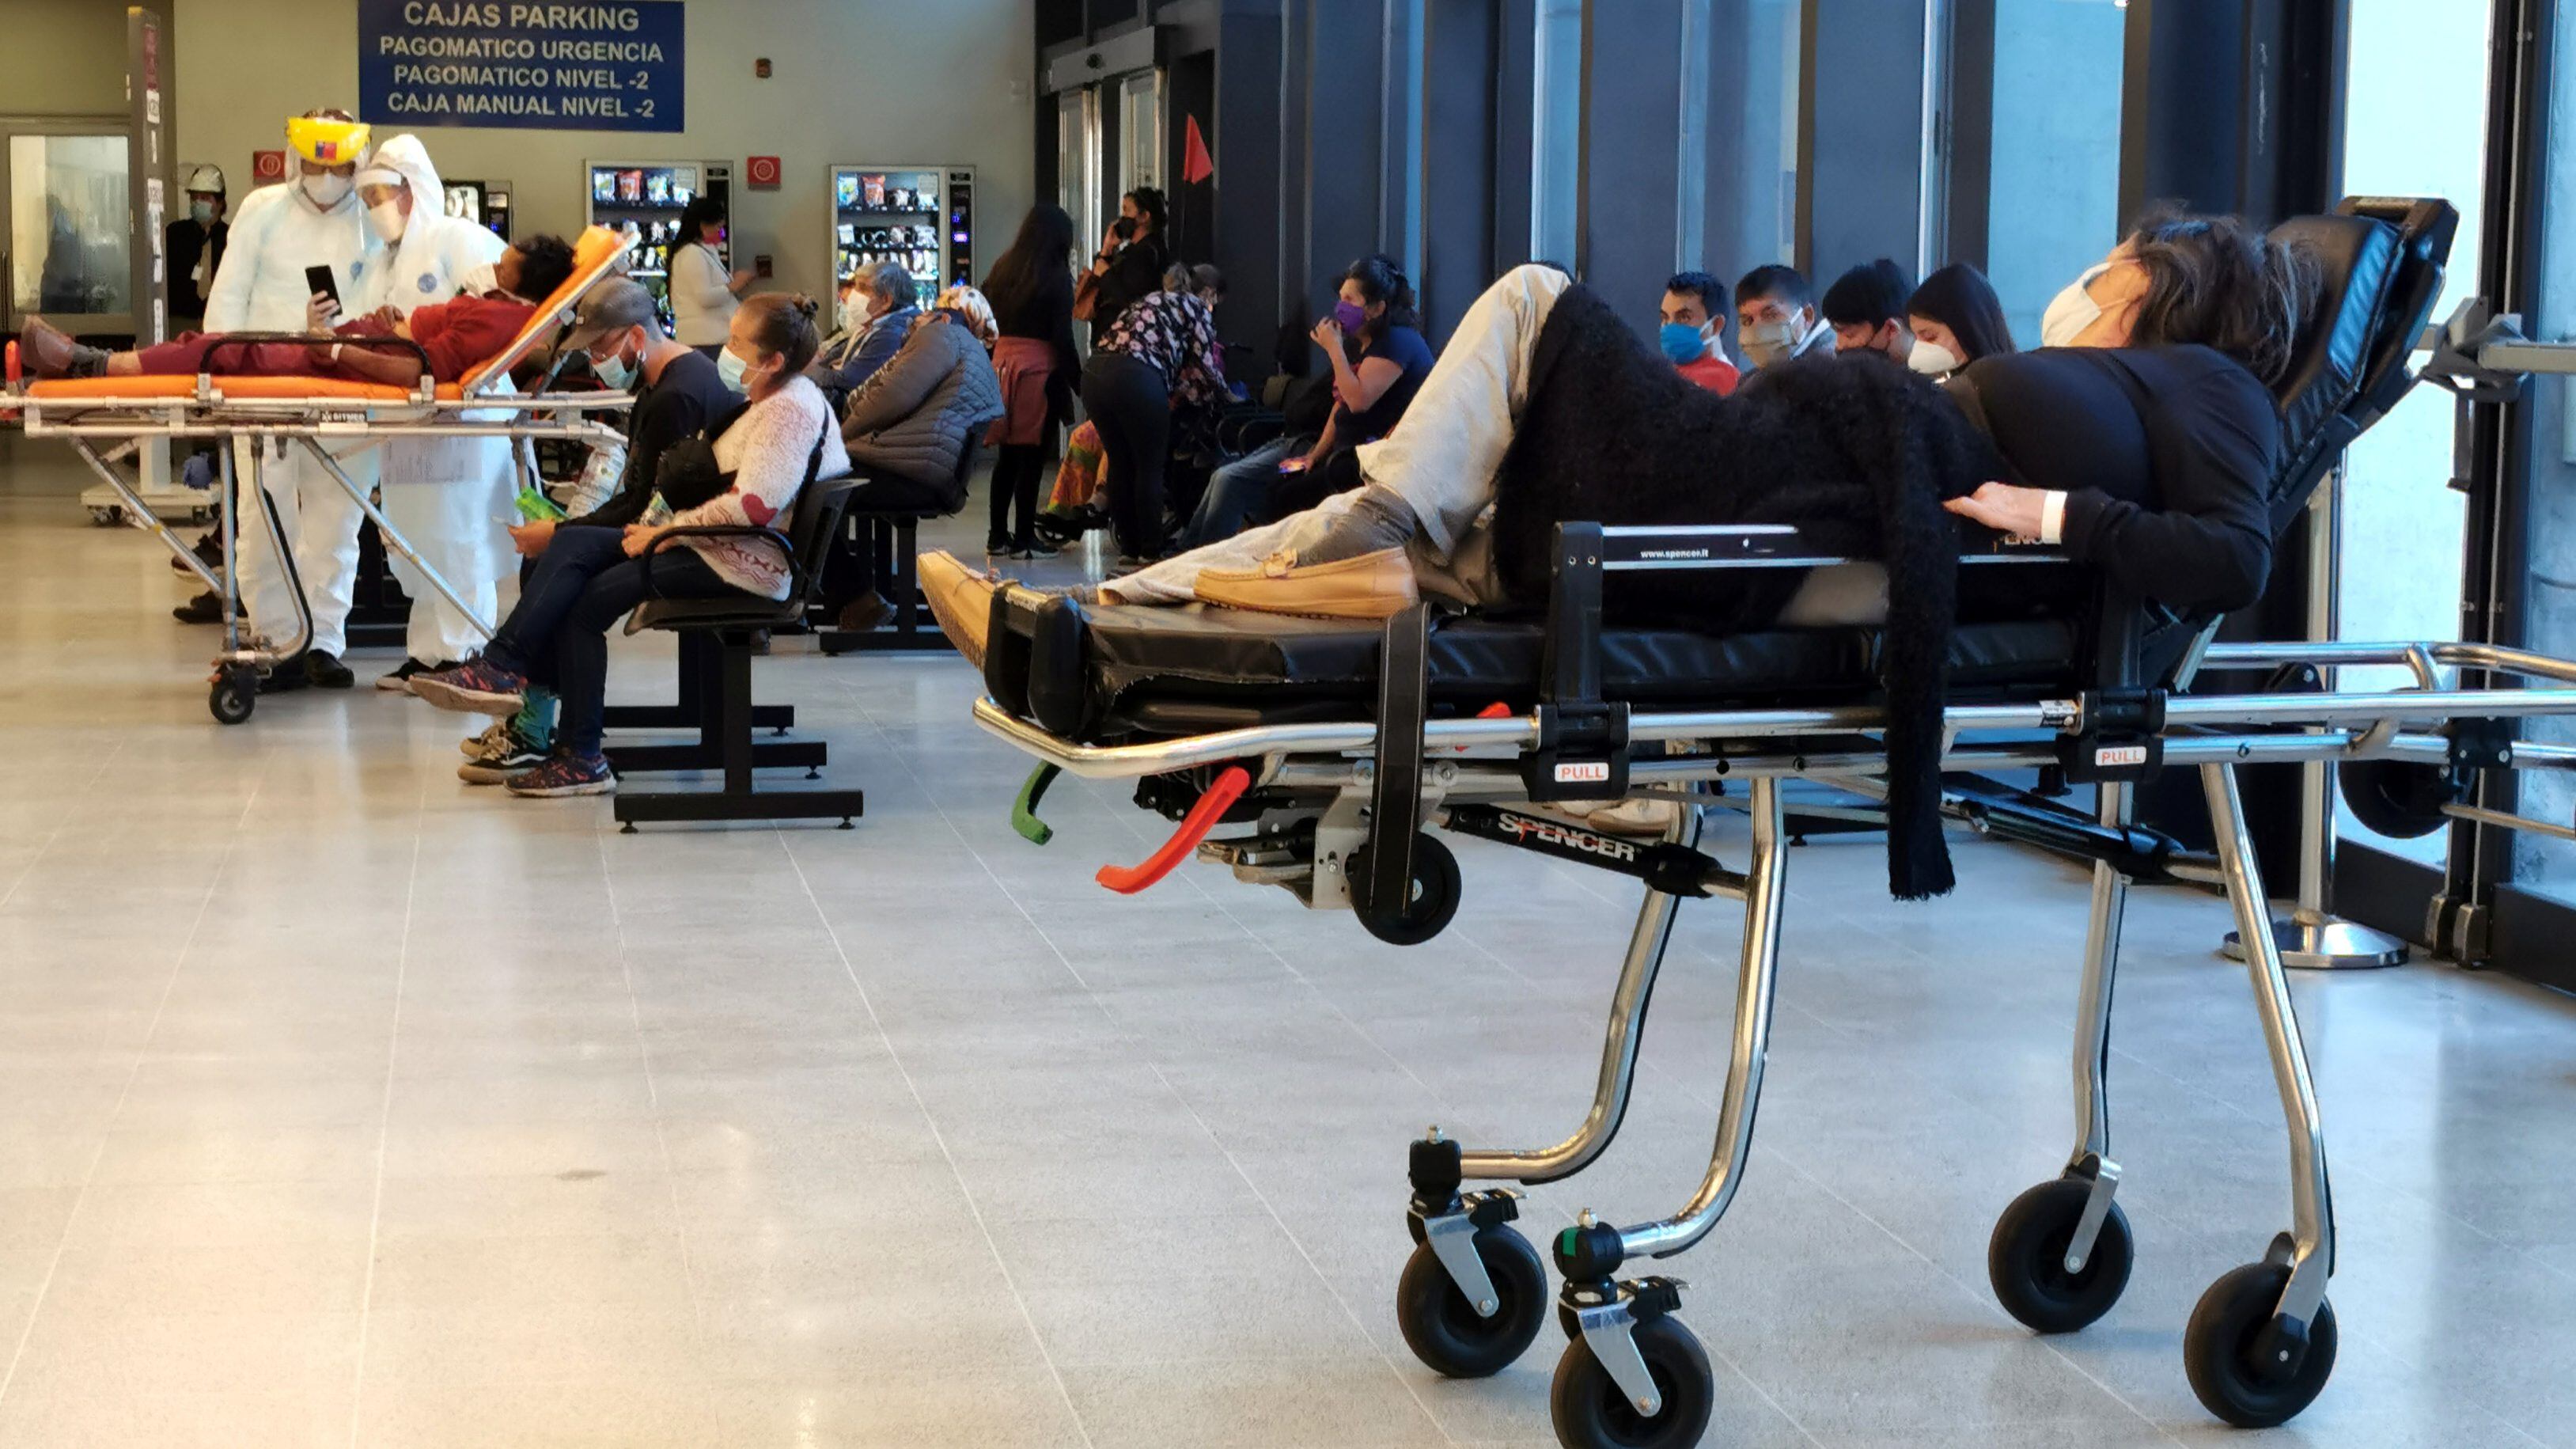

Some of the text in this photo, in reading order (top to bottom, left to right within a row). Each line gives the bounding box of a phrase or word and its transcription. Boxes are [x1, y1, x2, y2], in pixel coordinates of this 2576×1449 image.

[404, 2, 638, 31] CAJAS PARKING
[380, 36, 664, 63] PAGOMATICO URGENCIA
[394, 64, 650, 90] PAGOMATICO NIVEL -2
[388, 92, 655, 118] CAJA MANUAL NIVEL -2
[2101, 749, 2142, 764] PULL
[1561, 765, 1604, 780] PULL
